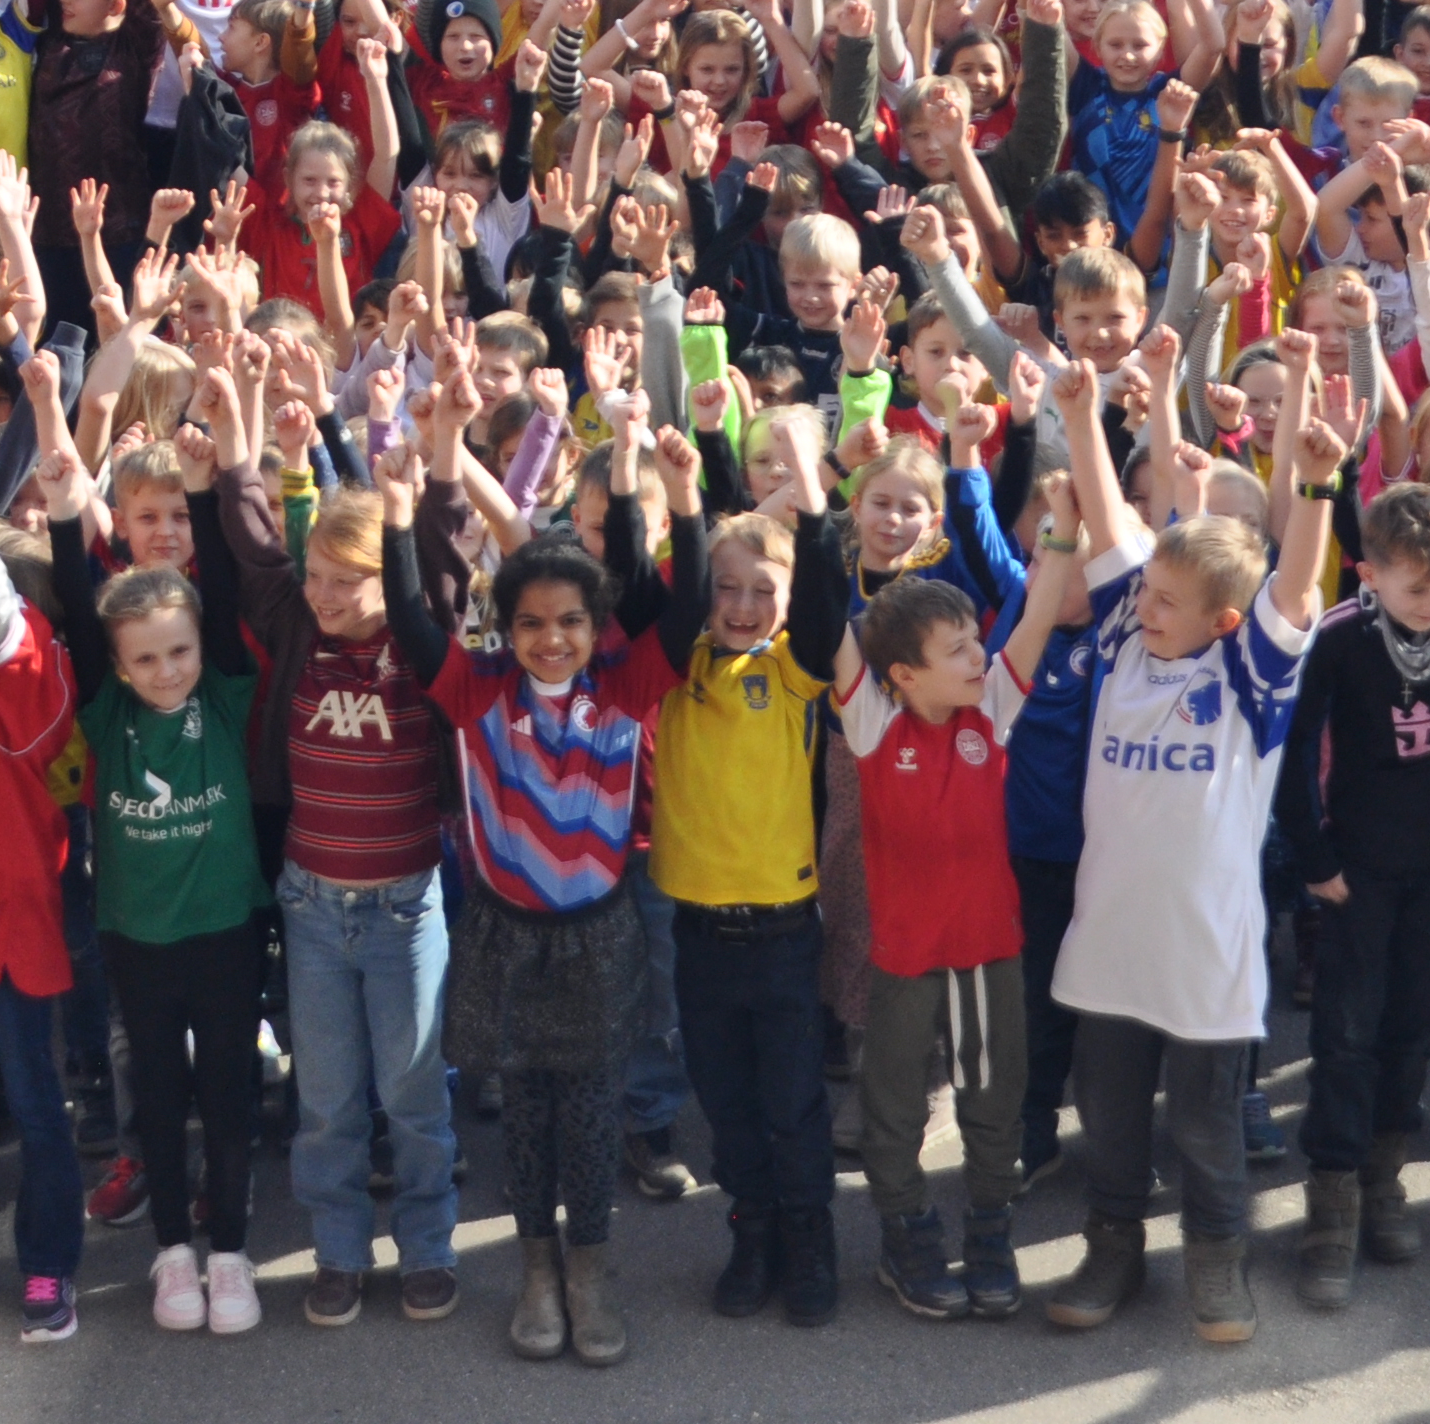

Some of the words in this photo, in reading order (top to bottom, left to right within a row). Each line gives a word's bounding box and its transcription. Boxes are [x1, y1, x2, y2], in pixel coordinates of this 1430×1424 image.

[305, 689, 393, 741] AXA
[1101, 734, 1215, 772] anica
[141, 827, 168, 840] take
[171, 825, 180, 837] it
